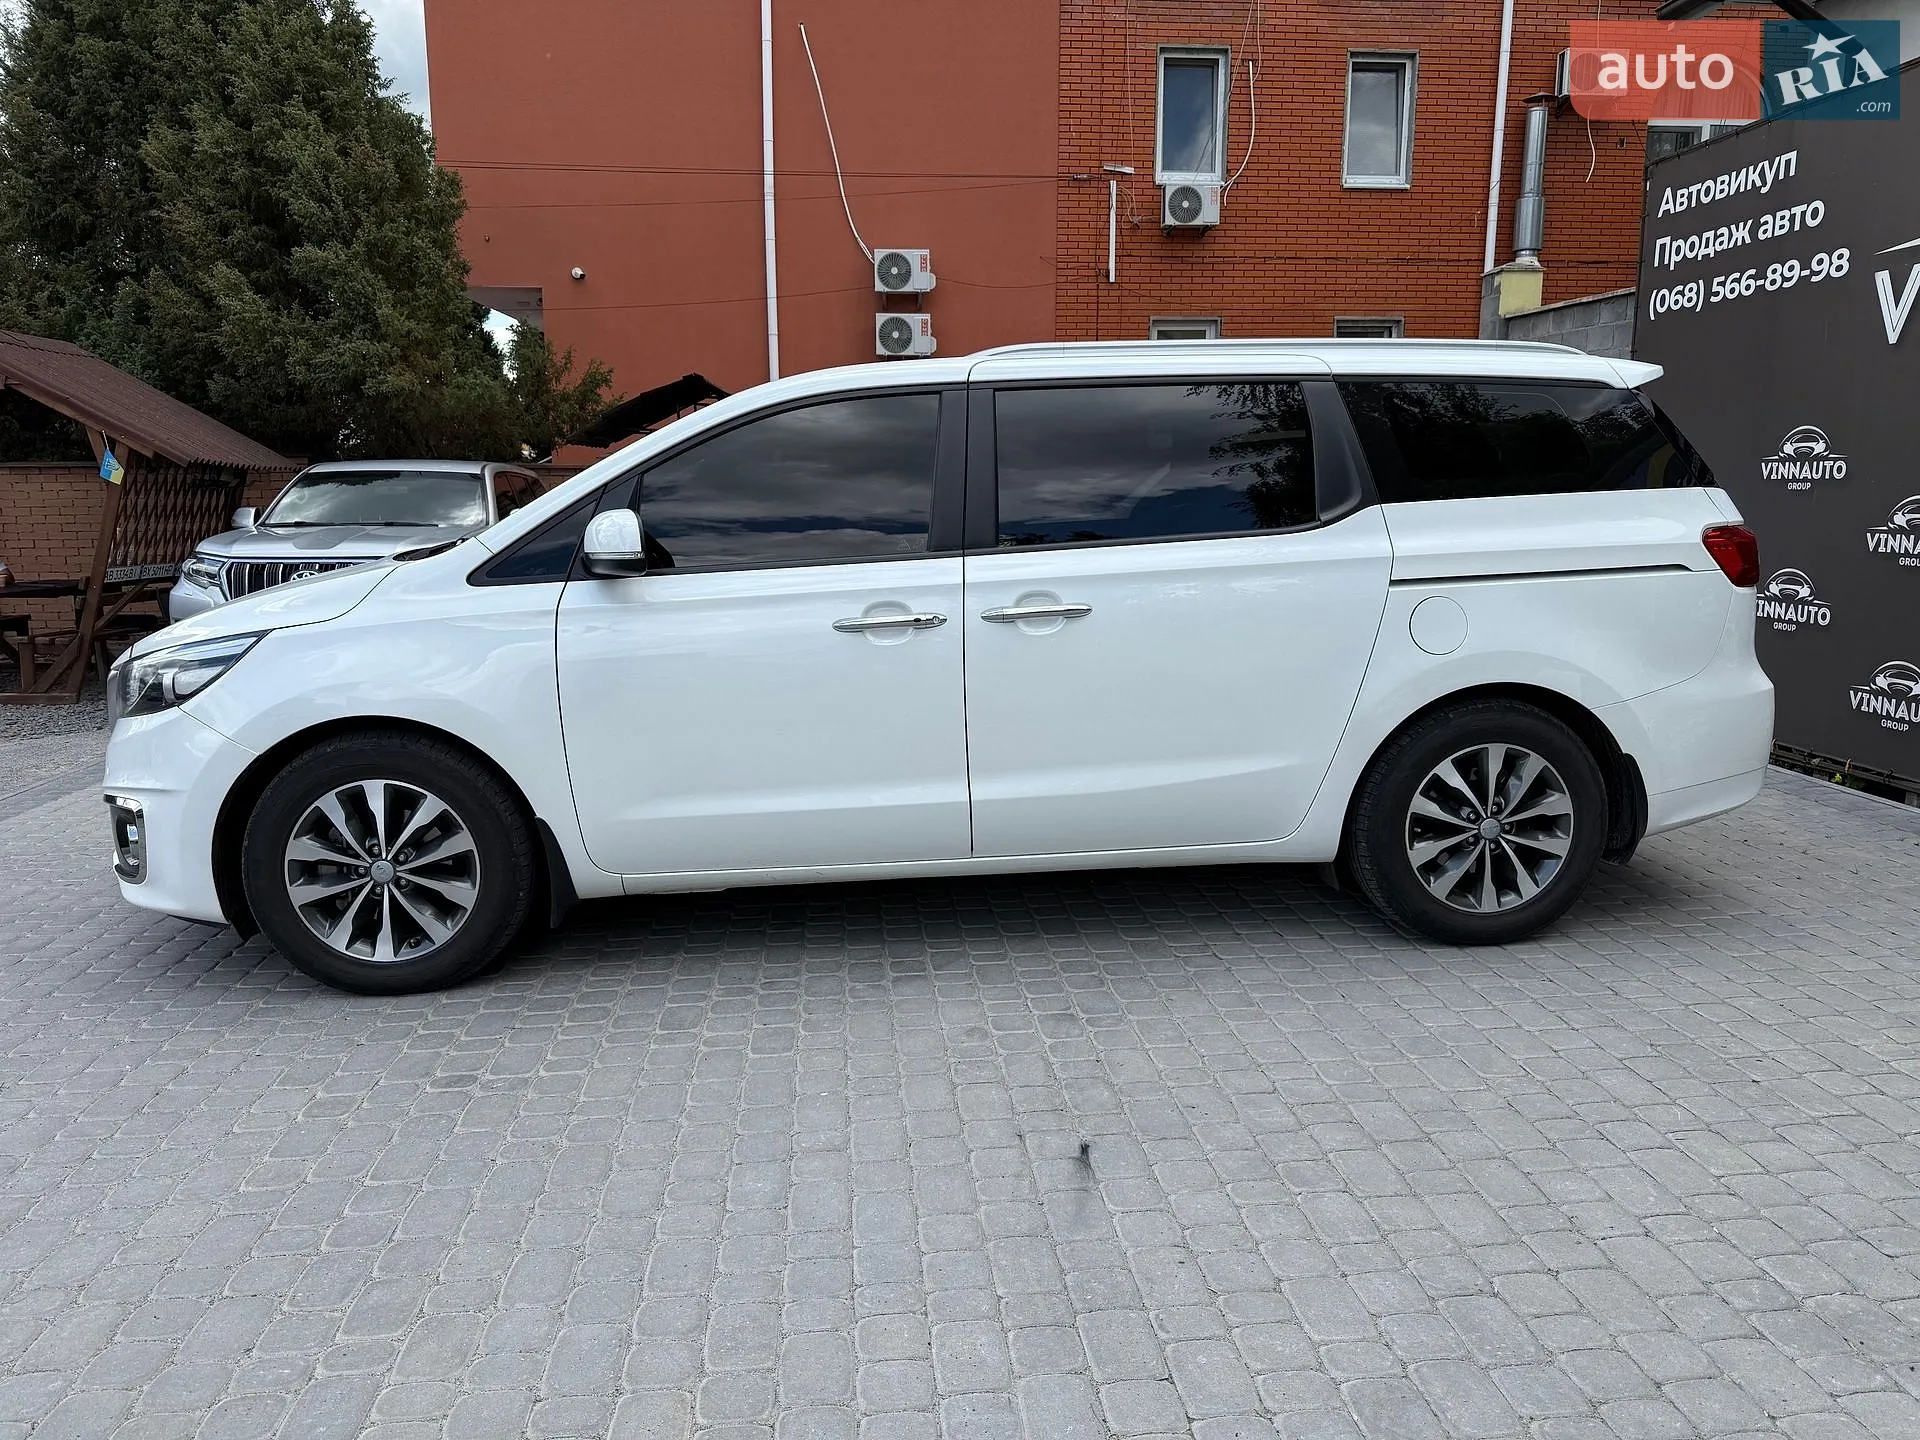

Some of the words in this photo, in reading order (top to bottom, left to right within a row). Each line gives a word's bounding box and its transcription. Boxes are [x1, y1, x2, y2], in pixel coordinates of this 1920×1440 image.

[1657, 150, 1798, 218] Автовикуп
[1653, 219, 1753, 270] Продаж
[1757, 200, 1825, 240] авто
[1649, 279, 1705, 321] (068)
[1709, 247, 1851, 303] 566-89-98
[1761, 460, 1847, 480] VINNAUTO
[1787, 482, 1812, 490] GROUP
[1756, 600, 1831, 626] INNAUTO
[1773, 621, 1797, 632] GROUP
[1880, 719, 1909, 732] GROUP
